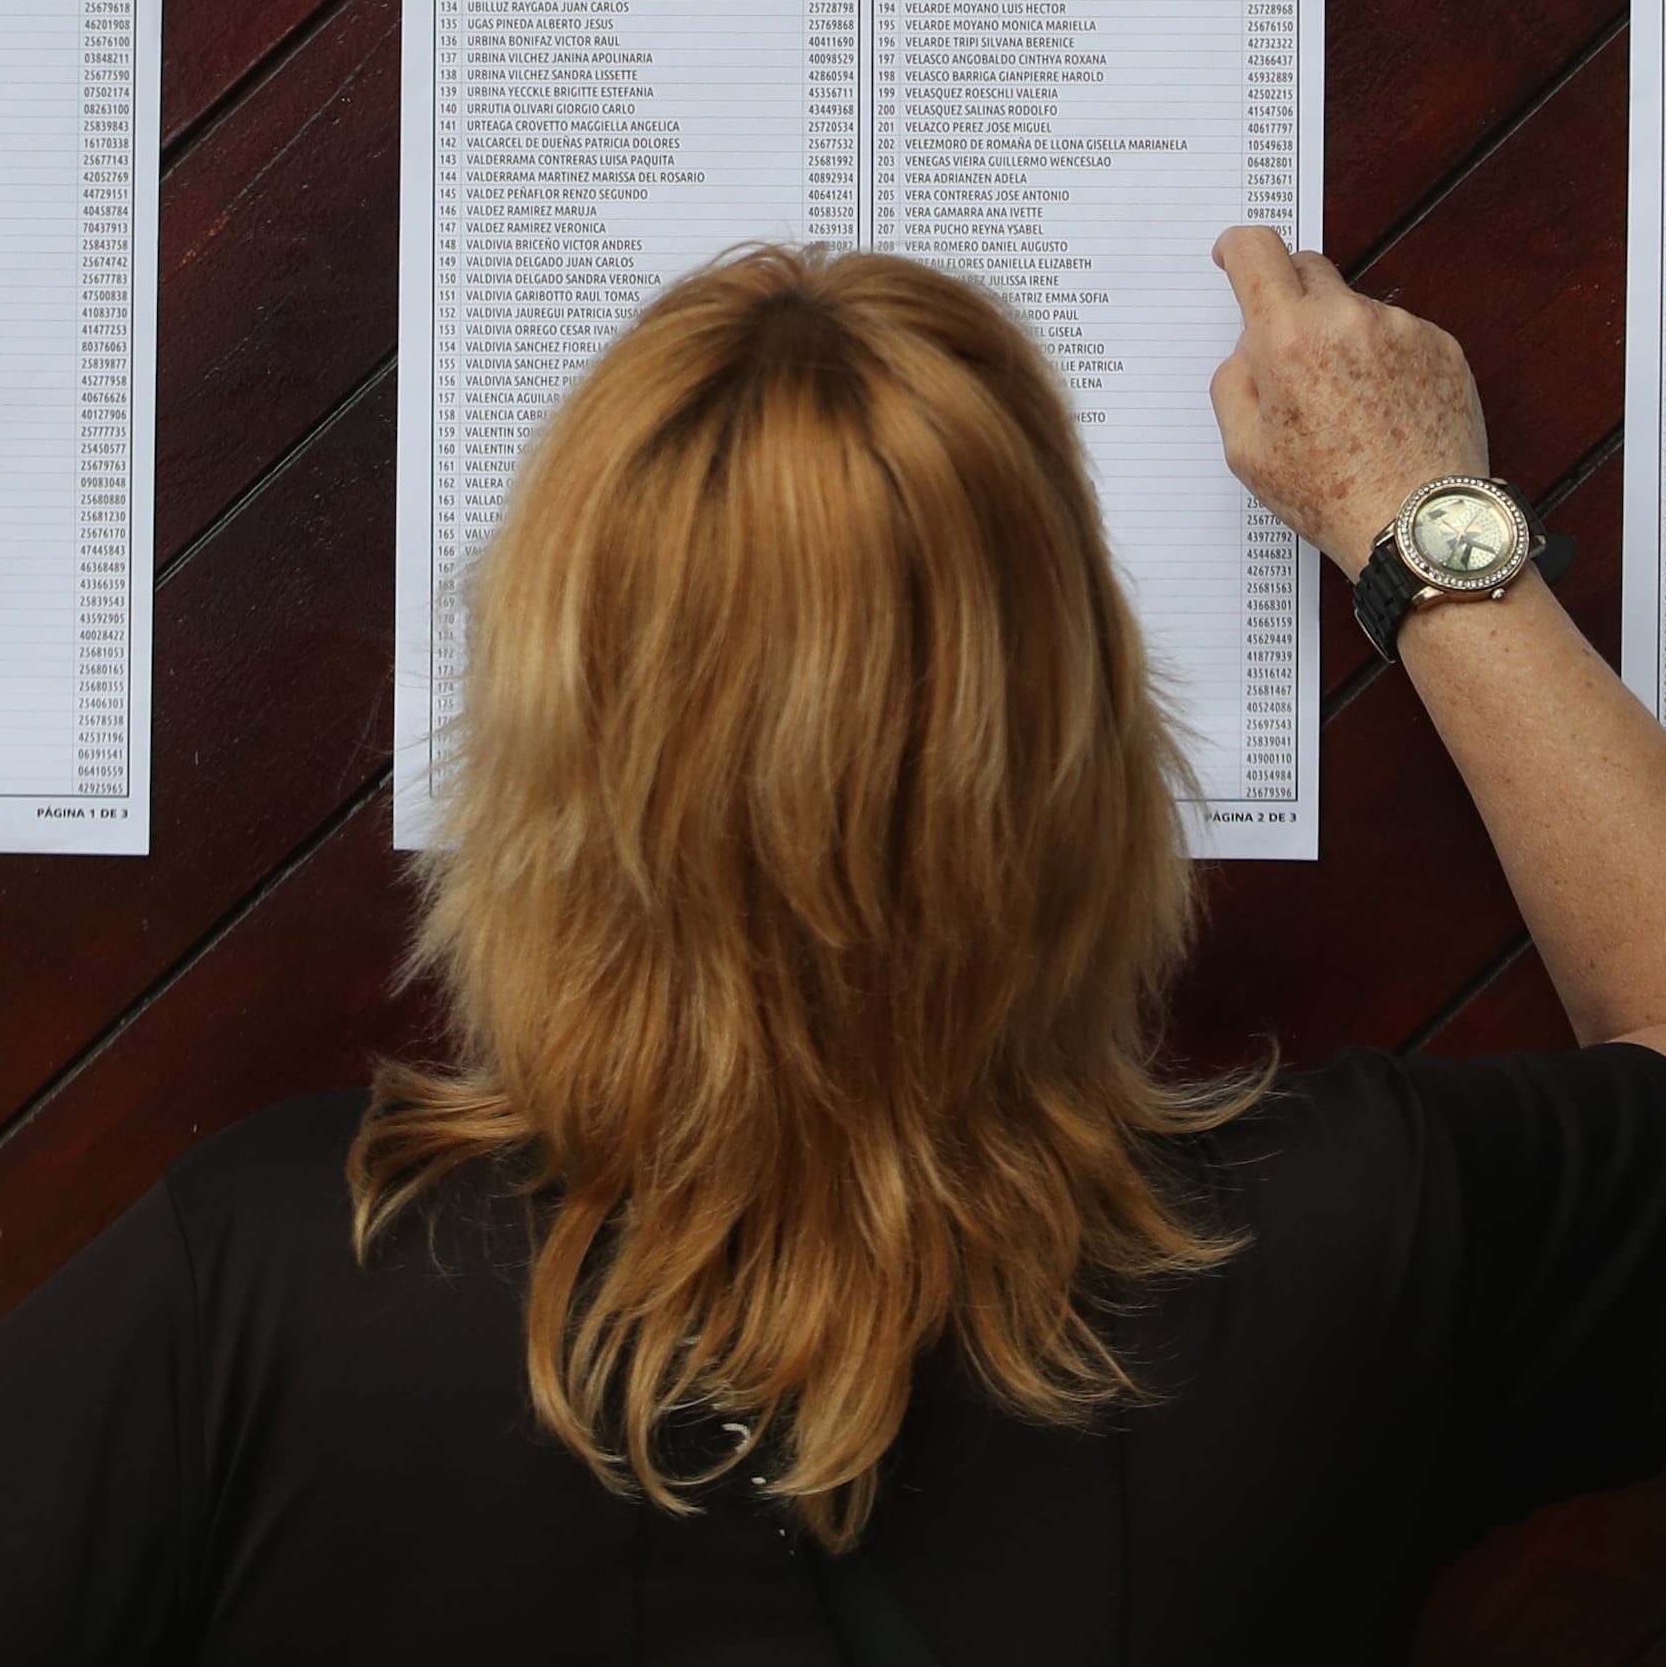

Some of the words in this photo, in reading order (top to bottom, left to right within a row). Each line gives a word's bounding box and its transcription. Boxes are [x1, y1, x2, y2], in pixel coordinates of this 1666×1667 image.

[37, 806, 84, 818] PÁGINA
[90, 808, 94, 818] 1
[100, 808, 116, 818] DE
[122, 809, 127, 818] 3
[1258, 812, 1264, 822] 2
[1268, 813, 1285, 822] DE
[1290, 812, 1296, 822] 3
